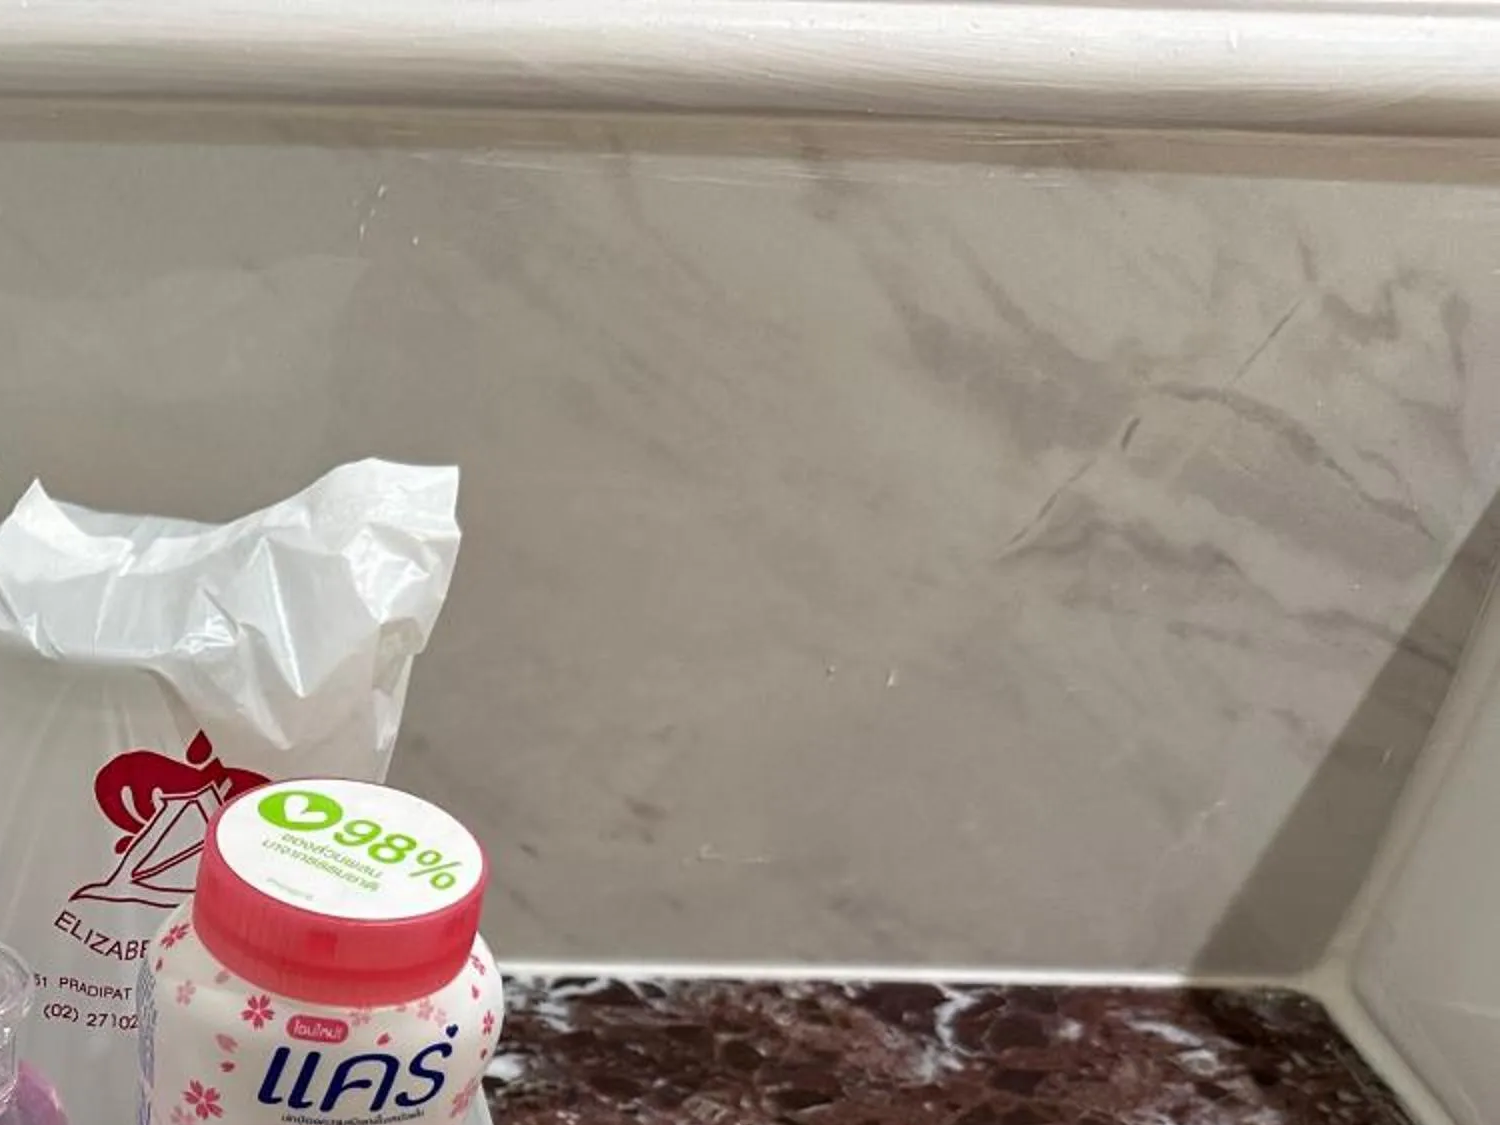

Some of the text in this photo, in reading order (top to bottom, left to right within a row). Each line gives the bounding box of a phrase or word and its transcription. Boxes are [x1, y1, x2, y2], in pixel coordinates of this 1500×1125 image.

[333, 819, 462, 890] 98%
[59, 976, 133, 1000] PRADIPAT
[43, 1003, 139, 1031] (02) 27102
[257, 1023, 459, 1113] แคร์
